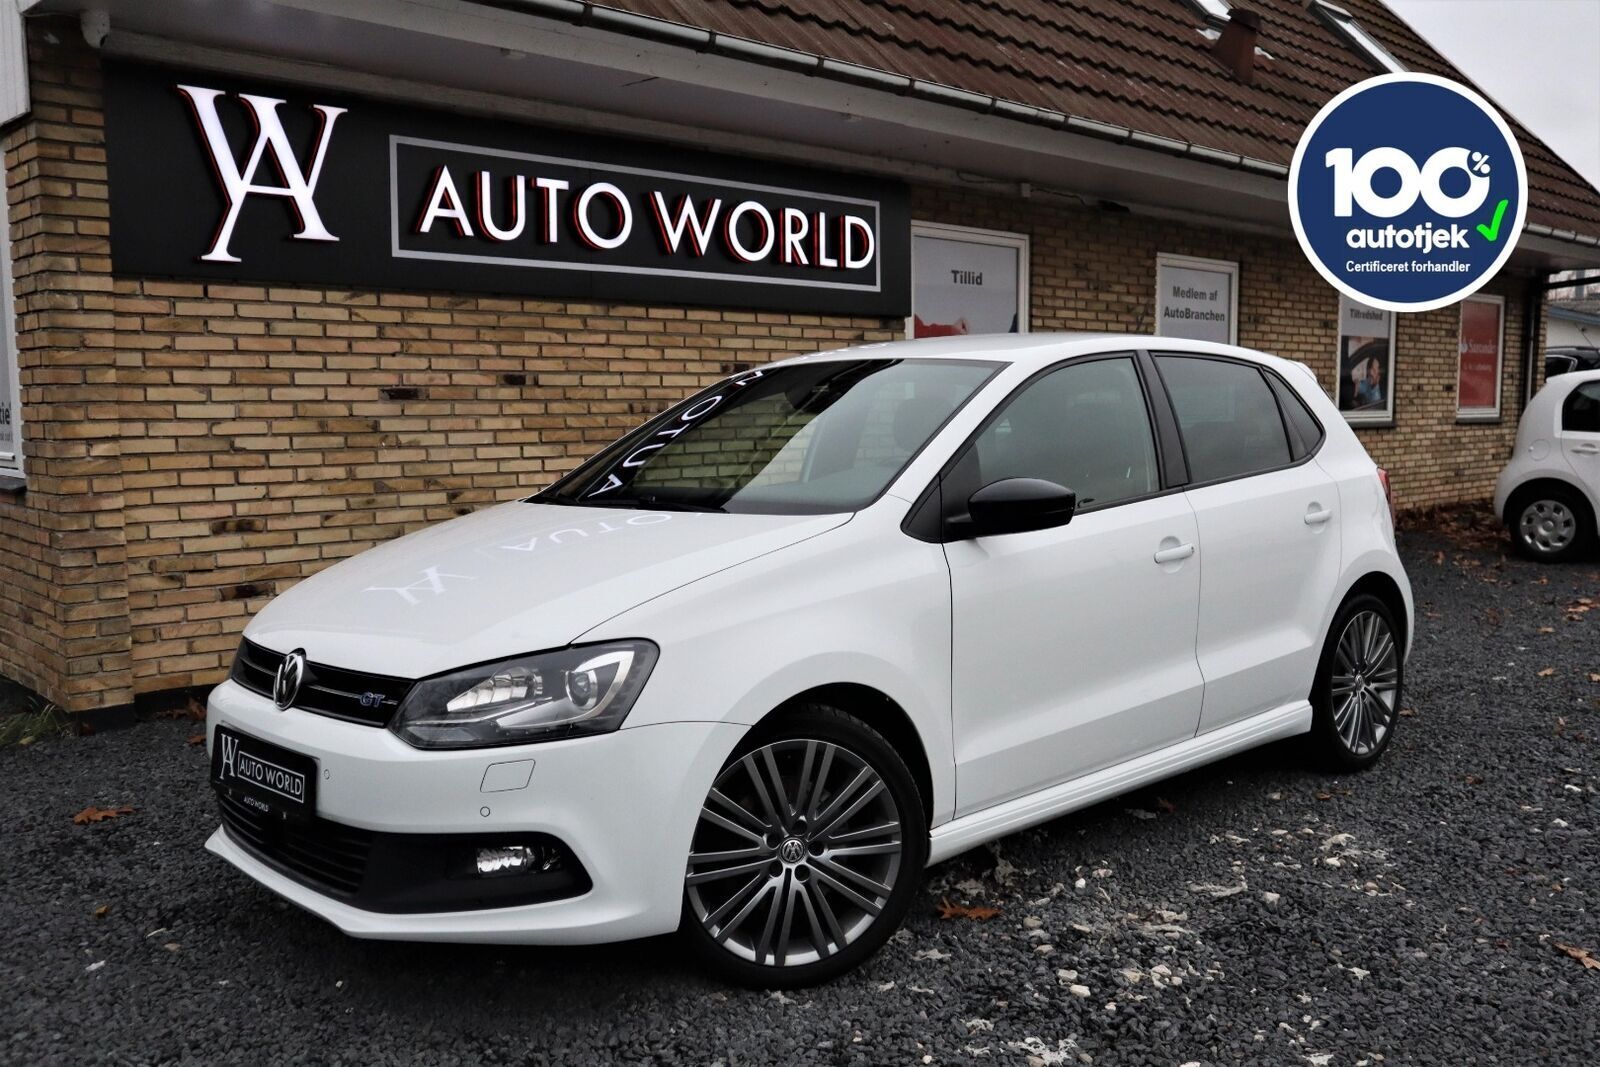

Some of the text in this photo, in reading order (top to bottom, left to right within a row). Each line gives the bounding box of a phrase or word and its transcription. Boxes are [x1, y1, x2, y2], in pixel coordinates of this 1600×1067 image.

[417, 164, 875, 270] AUTO WORLD
[950, 269, 983, 286] Tillid
[1172, 285, 1219, 302] Medlem af
[1163, 305, 1226, 322] AutoBranchen
[360, 692, 385, 707] GT
[239, 757, 302, 795] AUTO WORLD
